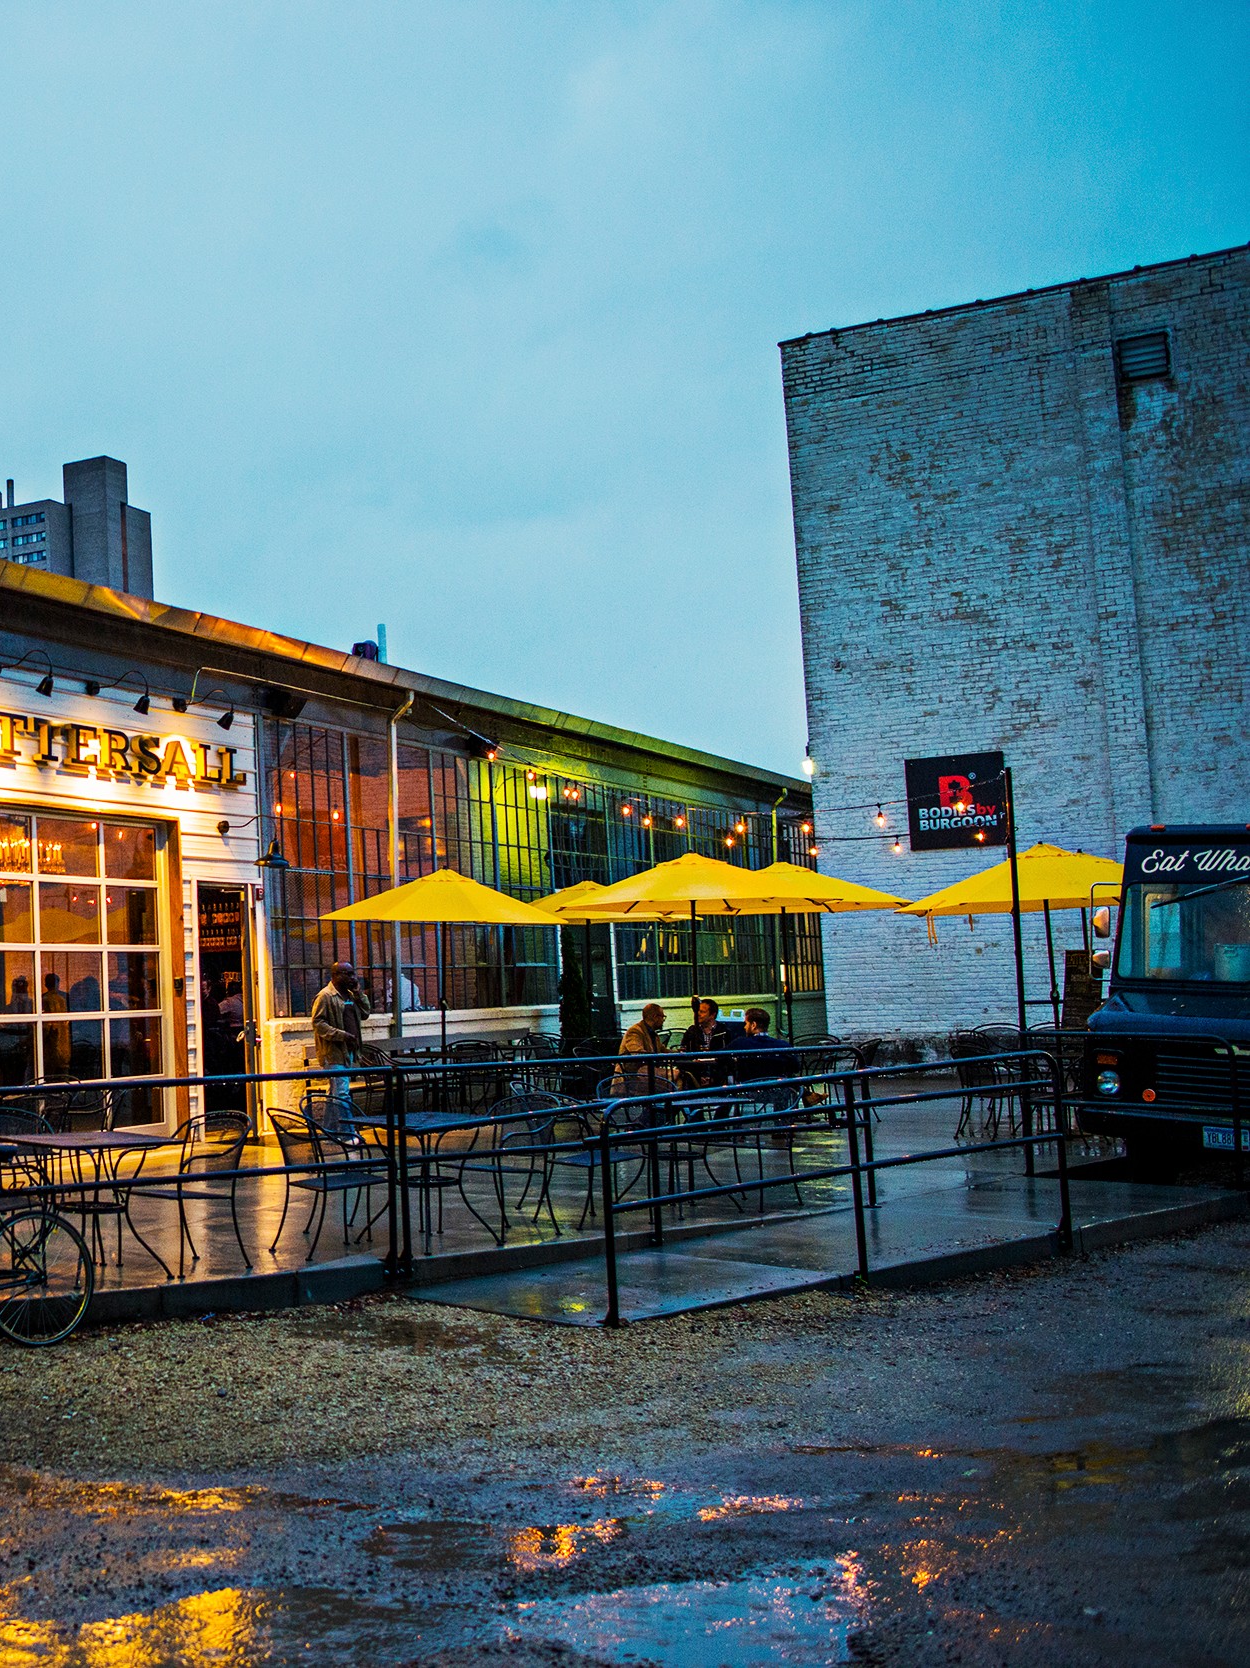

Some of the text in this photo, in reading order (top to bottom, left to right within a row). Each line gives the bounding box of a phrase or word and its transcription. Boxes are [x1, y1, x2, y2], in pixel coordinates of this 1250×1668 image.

[919, 815, 998, 831] BURGOON
[1141, 849, 1250, 873] Eat Wha
